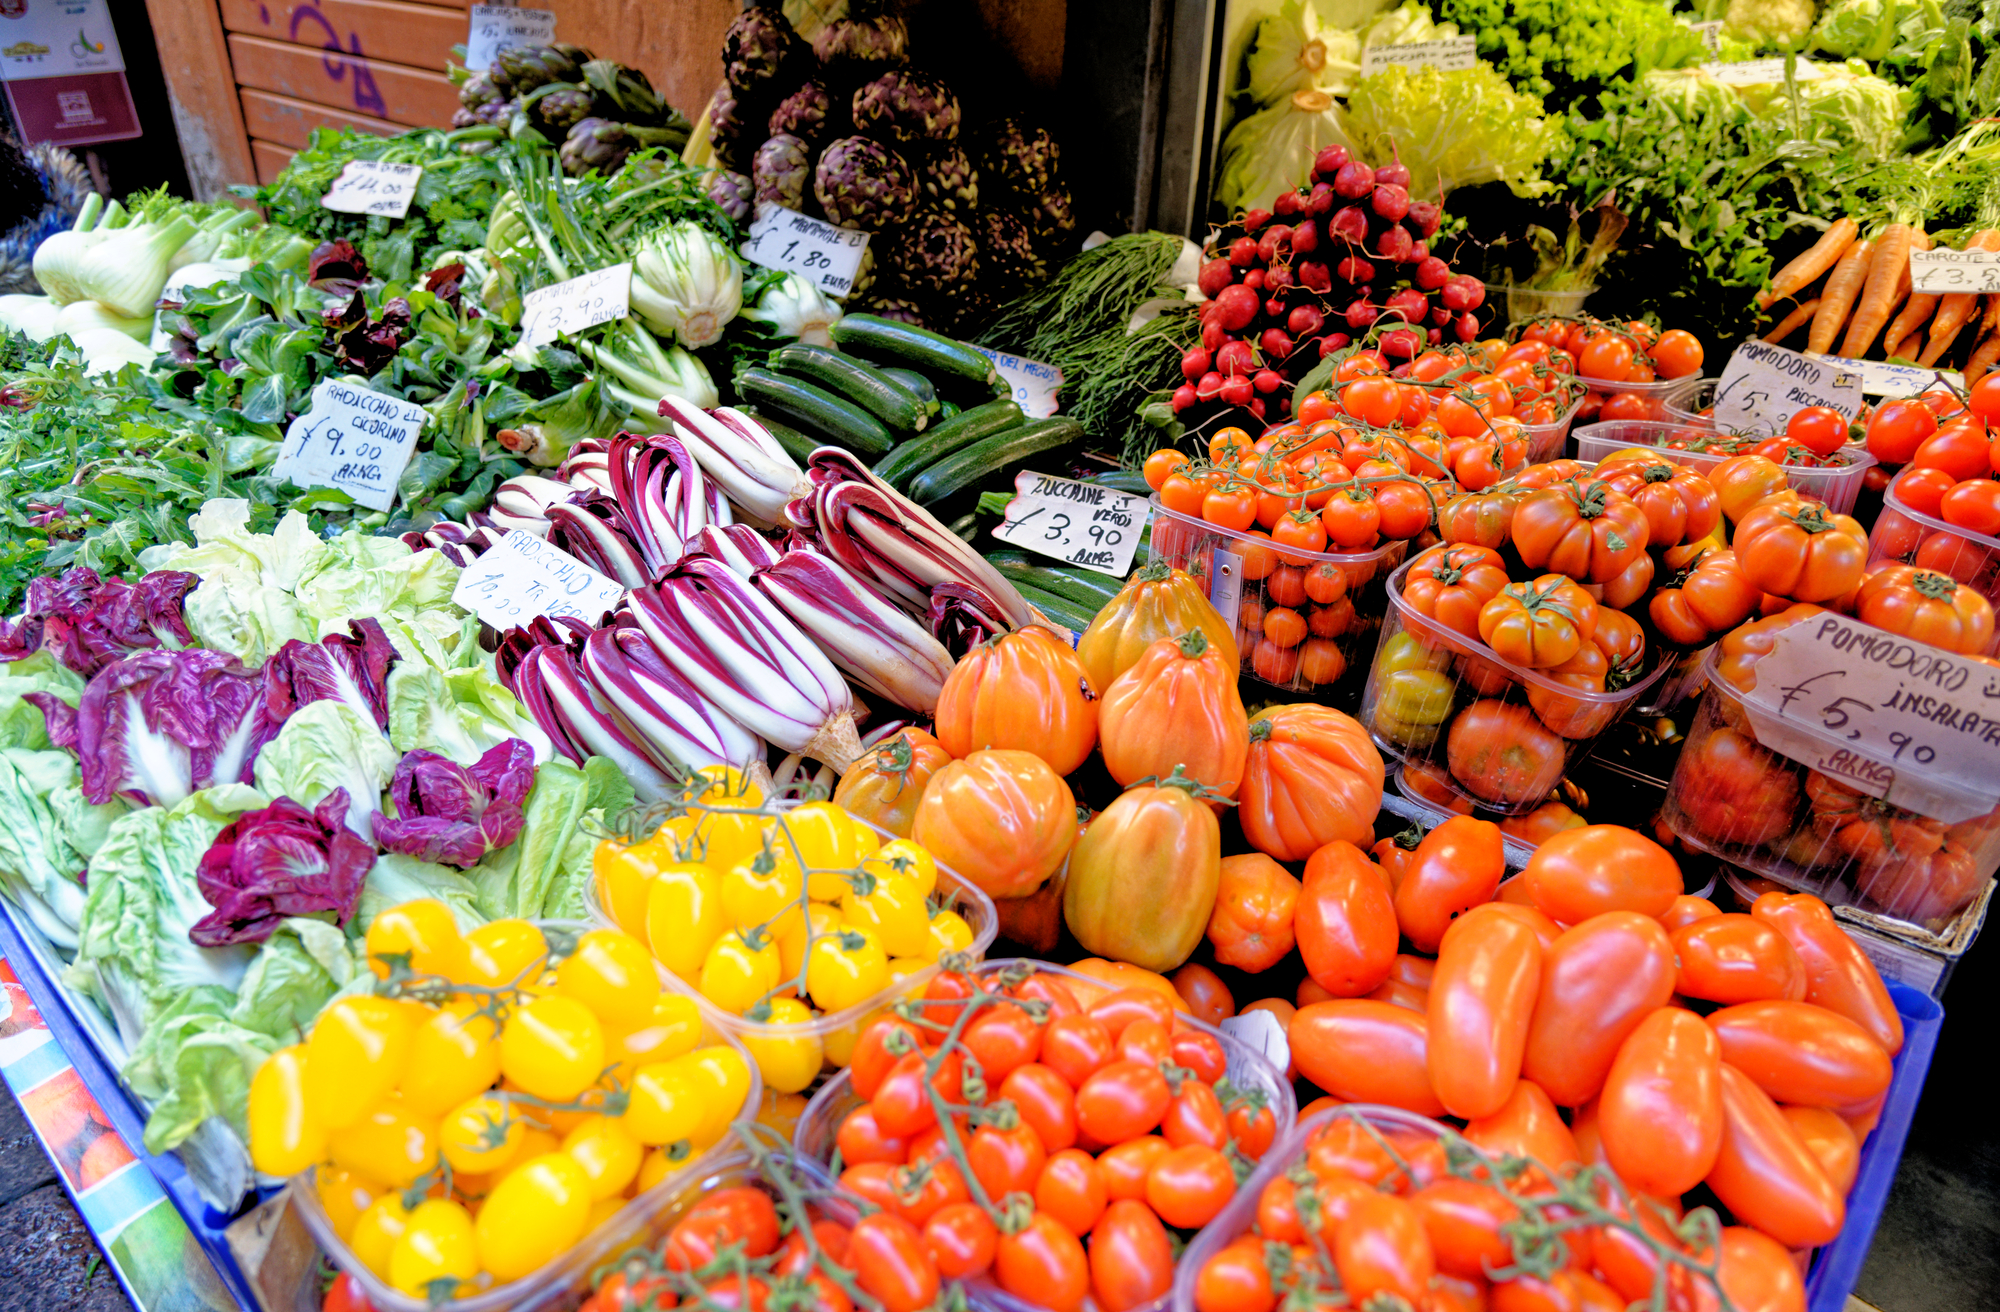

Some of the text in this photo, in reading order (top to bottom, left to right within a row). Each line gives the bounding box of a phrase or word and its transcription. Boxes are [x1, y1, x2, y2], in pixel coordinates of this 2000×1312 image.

[1913, 252, 1983, 263] CAROTE
[821, 273, 851, 292] EURO
[1001, 355, 1019, 371] DEL
[1739, 342, 1821, 386] POMODORO
[1816, 618, 1969, 692] POMODORO
[1822, 697, 1936, 765] 5,90
